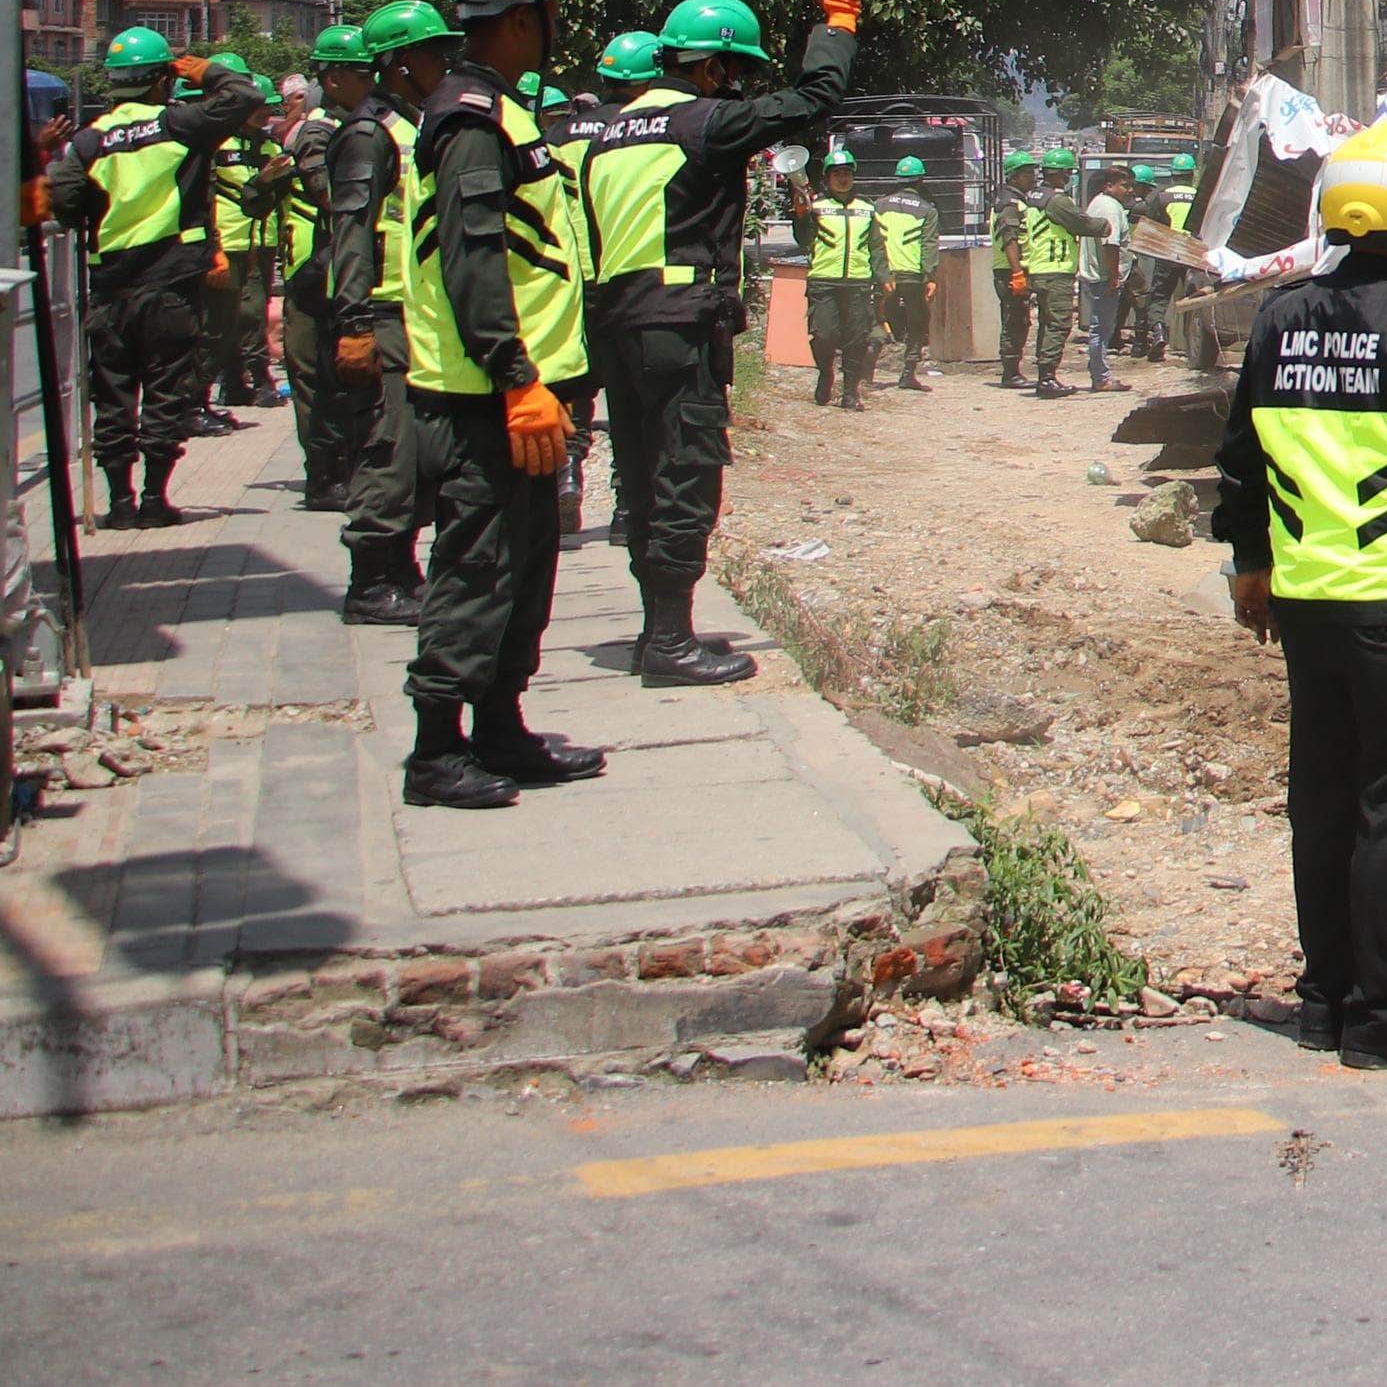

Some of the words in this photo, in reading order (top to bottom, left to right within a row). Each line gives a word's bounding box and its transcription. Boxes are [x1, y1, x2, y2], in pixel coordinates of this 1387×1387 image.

[603, 121, 626, 142] LMC
[627, 116, 670, 137] POLICE
[1280, 330, 1319, 357] LMC
[1323, 331, 1380, 360] POLICE
[1274, 363, 1337, 393] ACTION
[1338, 366, 1380, 394] TEAM
